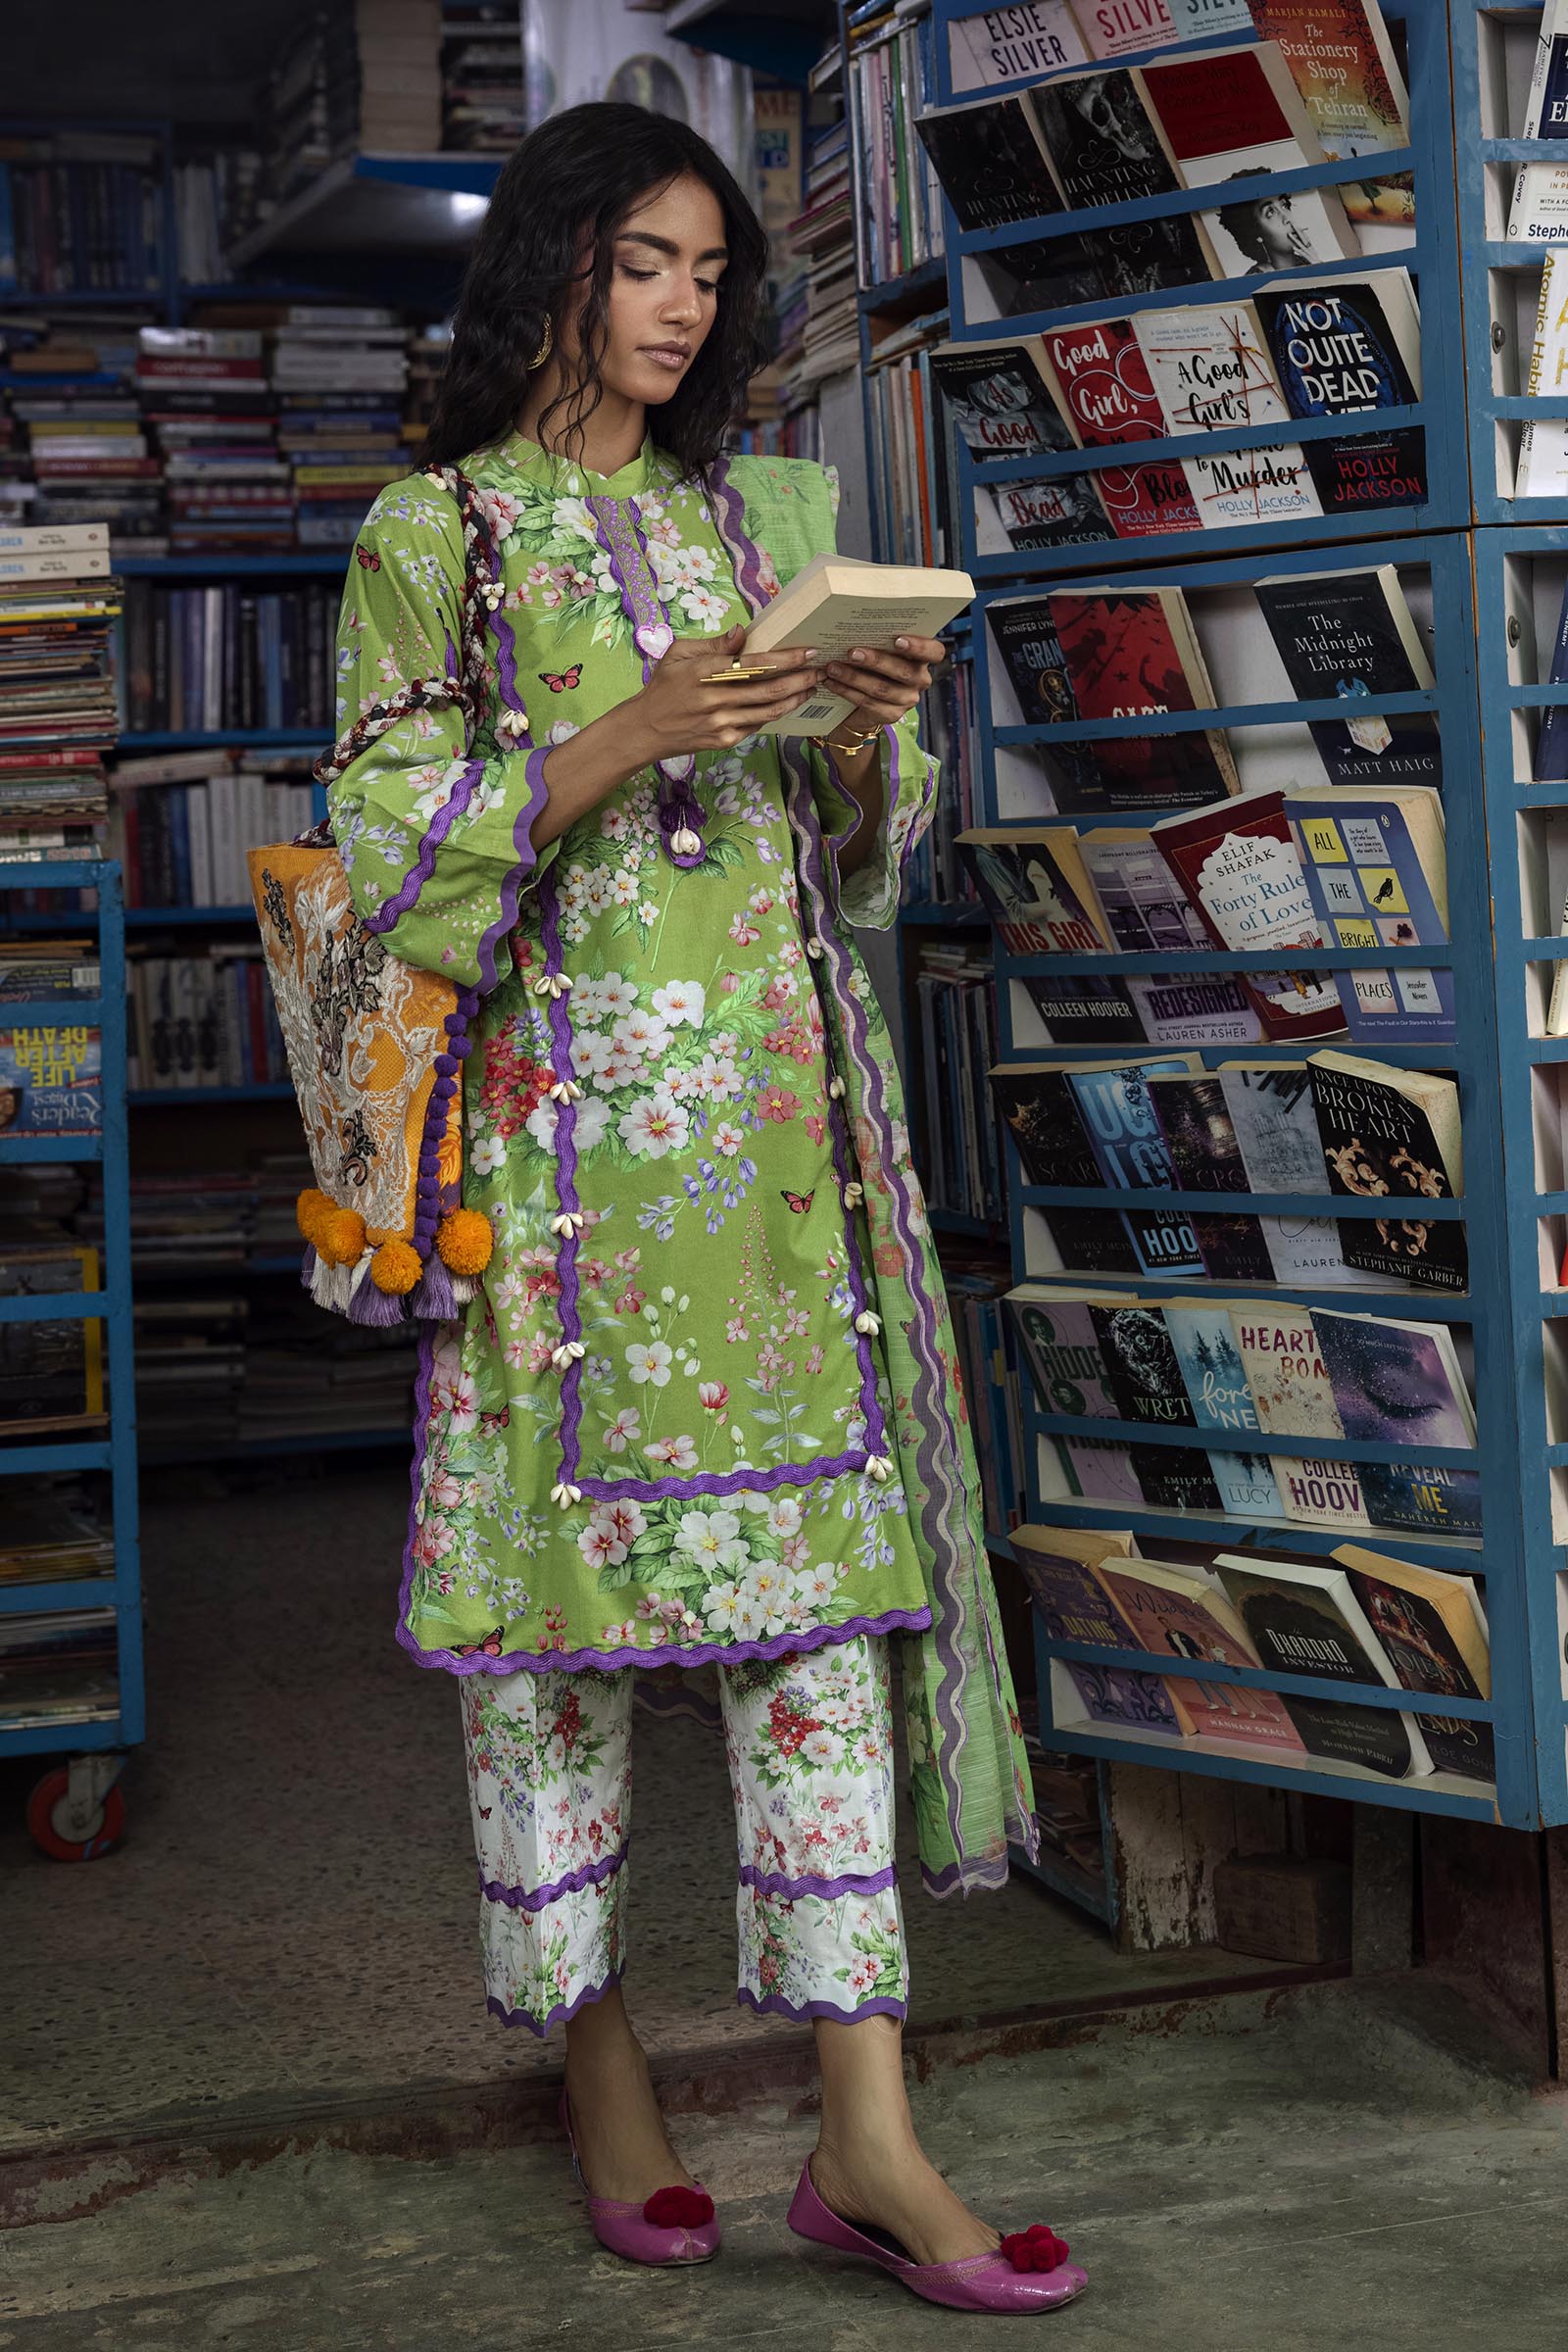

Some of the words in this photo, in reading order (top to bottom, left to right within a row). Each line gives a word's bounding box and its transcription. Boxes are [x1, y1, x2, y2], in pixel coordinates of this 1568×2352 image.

[983, 4, 1047, 42] ELSIE
[1097, 0, 1170, 38] SILVE
[1265, 7, 1304, 18] MARJAN
[1307, 7, 1347, 19] KAMALI
[1304, 24, 1323, 37] The
[991, 35, 1068, 76] SILVER
[1279, 38, 1358, 64] Stationery
[1306, 61, 1348, 86] Shop
[1329, 83, 1340, 98] of
[1308, 96, 1368, 118] Tehran
[1515, 173, 1526, 204] Covey
[1536, 253, 1556, 333] Atomic
[1284, 298, 1344, 333] NOT
[1053, 329, 1110, 376] Good
[1287, 332, 1374, 368] QUITE
[1178, 361, 1190, 384] A
[1192, 350, 1250, 387] Good
[1527, 342, 1545, 396] Habit
[1300, 368, 1381, 405] DEAD
[1079, 383, 1138, 427] Girl,
[1189, 389, 1250, 431] Girl's
[980, 413, 1042, 446] Good
[1520, 421, 1530, 448] Clear
[1526, 419, 1537, 452] James
[1194, 454, 1208, 472] to
[1210, 456, 1298, 494] Murder
[1337, 455, 1398, 479] HOLLY
[1143, 471, 1193, 508] Blo
[1333, 476, 1422, 503] JACKSON
[1008, 490, 1066, 525] Dead
[1117, 509, 1158, 524] HOLLY
[1163, 505, 1200, 521] JACKS
[1216, 499, 1252, 513] HOLLY
[1258, 495, 1310, 510] JACKSON
[1014, 536, 1052, 551] HOLLY
[1058, 530, 1109, 549] JACKSON
[1307, 613, 1343, 631] The
[1021, 637, 1066, 669] GRAN
[1294, 630, 1374, 654] Midnight
[1307, 654, 1374, 672] Library
[1338, 760, 1382, 776] MATT
[1390, 758, 1434, 773] HAIG
[1221, 842, 1255, 862] ELIF
[1314, 833, 1336, 851] ALL
[1216, 849, 1276, 877] SHAFAK
[1242, 871, 1262, 886] The
[1331, 882, 1351, 900] THE
[1209, 891, 1259, 916] Forty
[1259, 871, 1305, 901] Rule
[1240, 911, 1258, 932] of
[1260, 896, 1313, 926] Love
[998, 921, 1050, 952] THIS
[1048, 919, 1104, 951] GIRL
[1340, 932, 1379, 949] BRIGHT
[1145, 982, 1249, 1020] REDESIGNED
[1296, 993, 1338, 1007] INTERNATIONA
[1354, 982, 1394, 999] PLACES
[1041, 1001, 1089, 1017] COLLEEN
[1087, 1001, 1133, 1017] HOOVER
[13, 1026, 88, 1047] DEATH
[1157, 1029, 1205, 1041] LAUREN
[1210, 1027, 1248, 1039] ASHER
[15, 1045, 88, 1067] AFTER
[30, 1064, 76, 1088] LIFE
[1314, 1069, 1351, 1089] ONCE
[1354, 1079, 1392, 1098] UPON
[32, 1091, 78, 1106] Digest
[1315, 1082, 1416, 1124] BROKEN
[1329, 1108, 1411, 1143] HEART
[1143, 1225, 1199, 1256] HOO
[1294, 1258, 1344, 1268] LAUREN
[1348, 1255, 1413, 1275] STEPHANIE
[1418, 1268, 1464, 1287] GARBER
[1241, 1326, 1316, 1353] HEART
[1035, 1346, 1108, 1380] HIDDE
[1280, 1356, 1330, 1380] BON
[1199, 1370, 1252, 1419] fore
[1133, 1395, 1191, 1421] WRET
[1163, 1475, 1198, 1486] EMILY
[1302, 1459, 1359, 1481] COLLEE
[1390, 1463, 1456, 1487] REVEAL
[1228, 1488, 1271, 1504] LUCY
[1291, 1478, 1360, 1511] HOOV
[1411, 1483, 1448, 1514] ME
[1394, 1510, 1447, 1525] TAHEREH
[1059, 1615, 1117, 1641] DATING
[1265, 1628, 1348, 1664] DHANDHO
[1282, 1655, 1355, 1675] INVESTOR
[1210, 1718, 1252, 1733] HANNAH
[1254, 1725, 1288, 1738] GRACE
